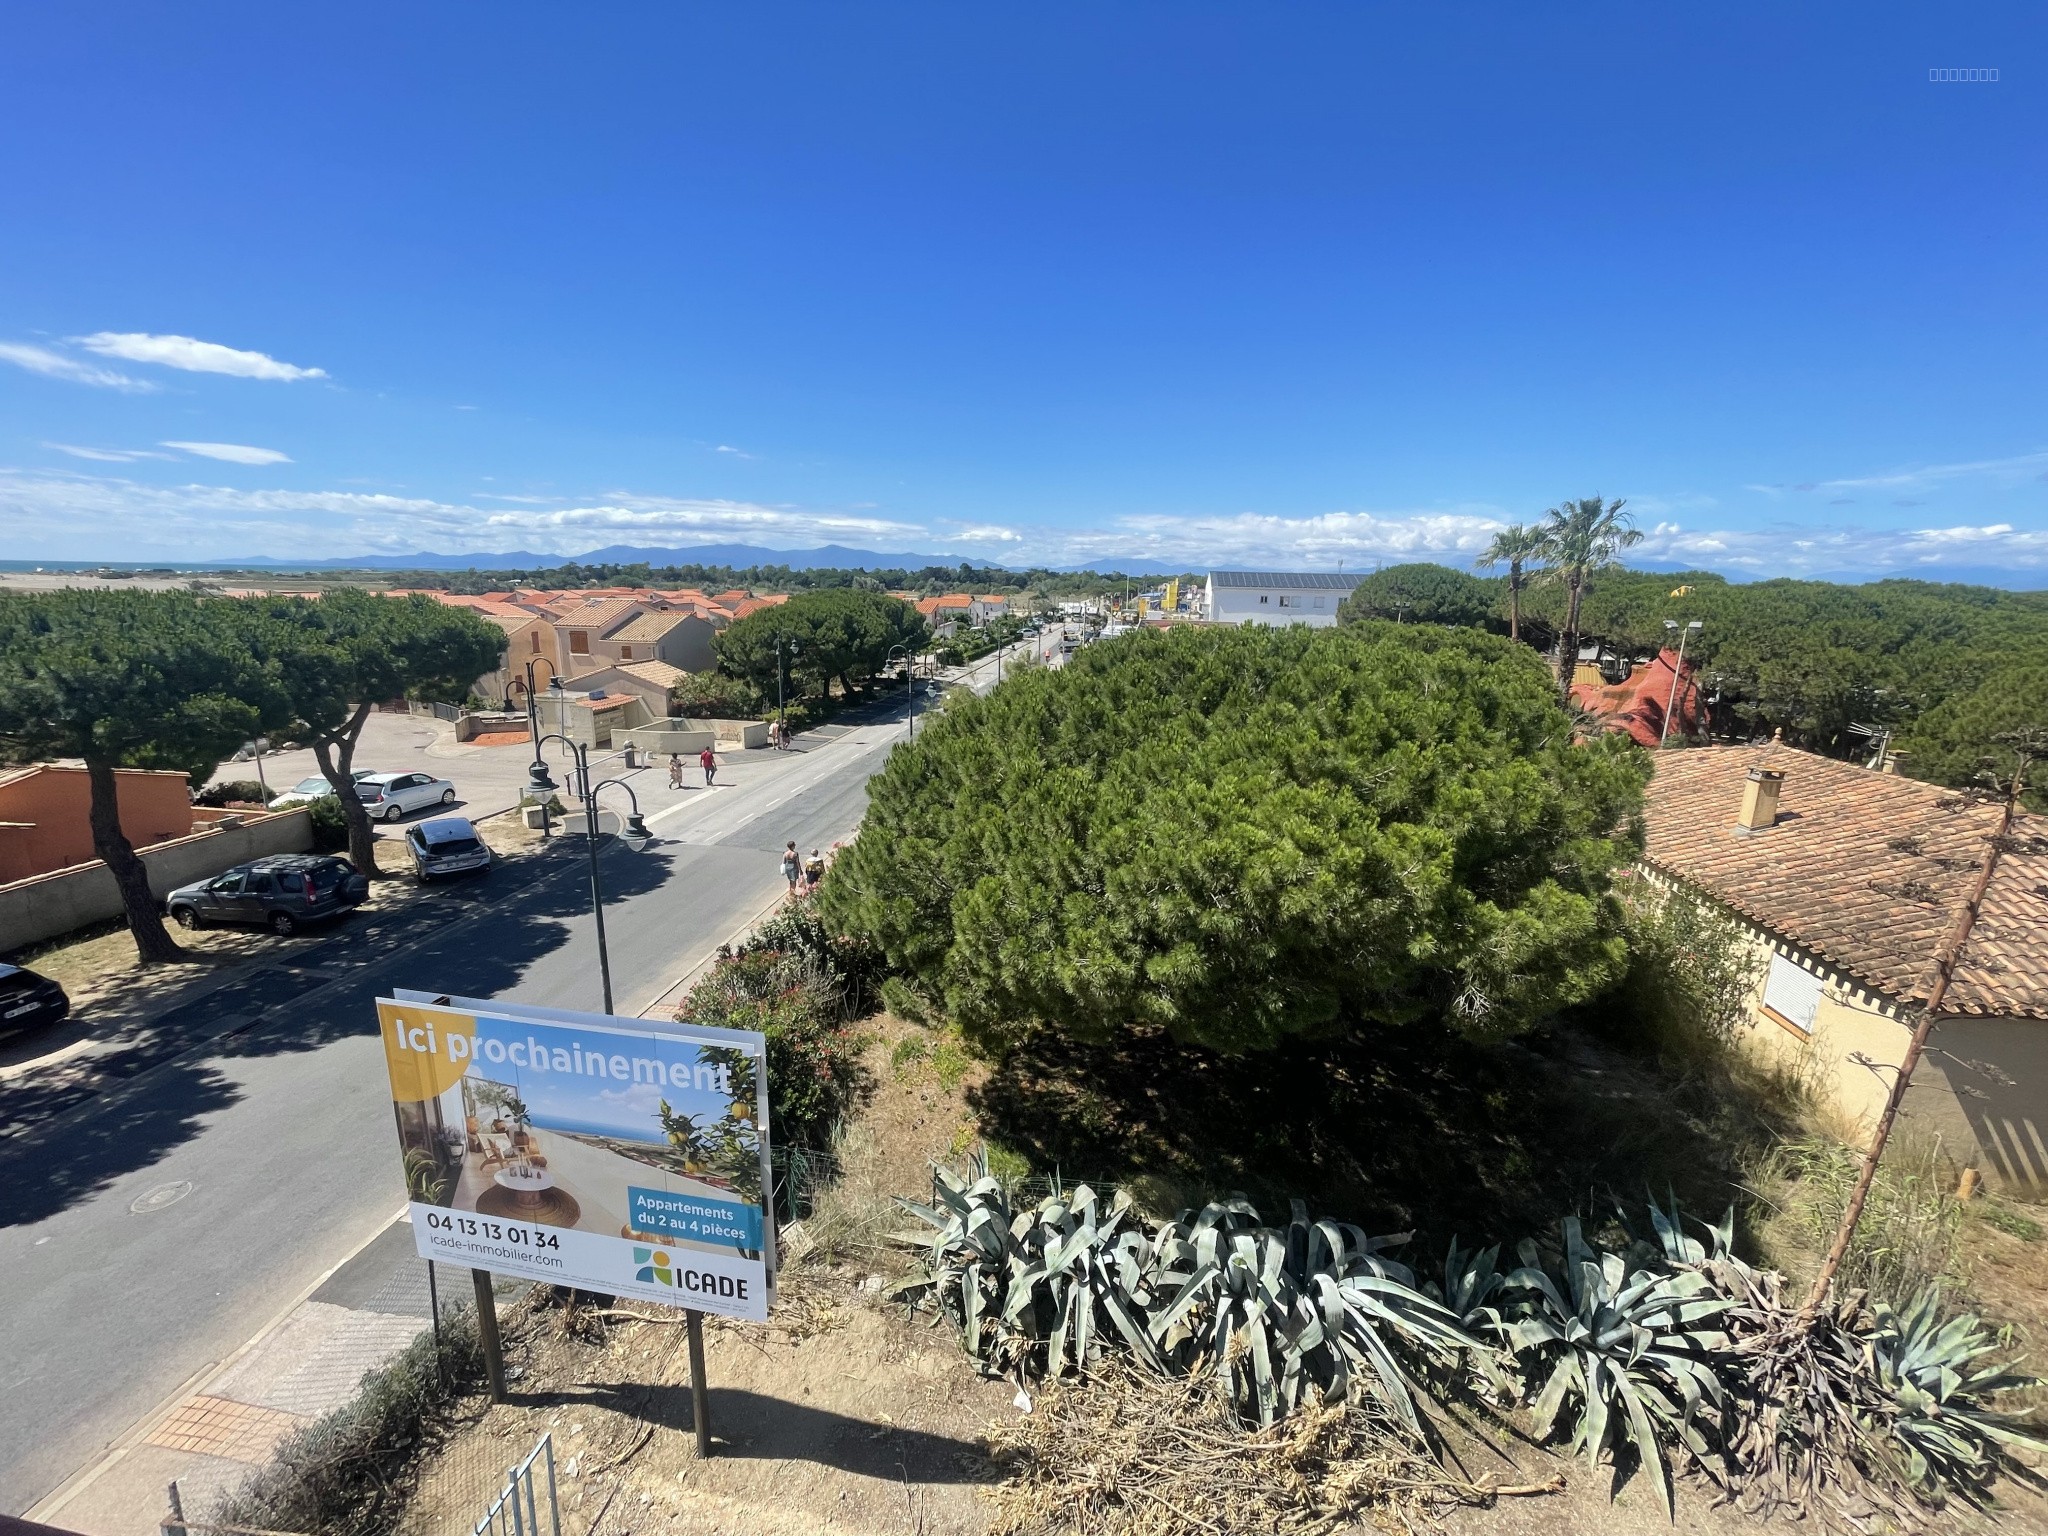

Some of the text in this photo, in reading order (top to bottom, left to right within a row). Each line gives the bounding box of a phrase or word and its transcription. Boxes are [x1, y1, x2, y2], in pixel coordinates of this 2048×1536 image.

[396, 1019, 733, 1094] Ici prochainement
[637, 1195, 734, 1221] Appartements
[427, 1212, 560, 1250] 04 13 13 01 34
[638, 1212, 746, 1240] du 2 au 4 pièces
[430, 1233, 563, 1268] icade-immobilier.com
[676, 1268, 749, 1300] ICADE
